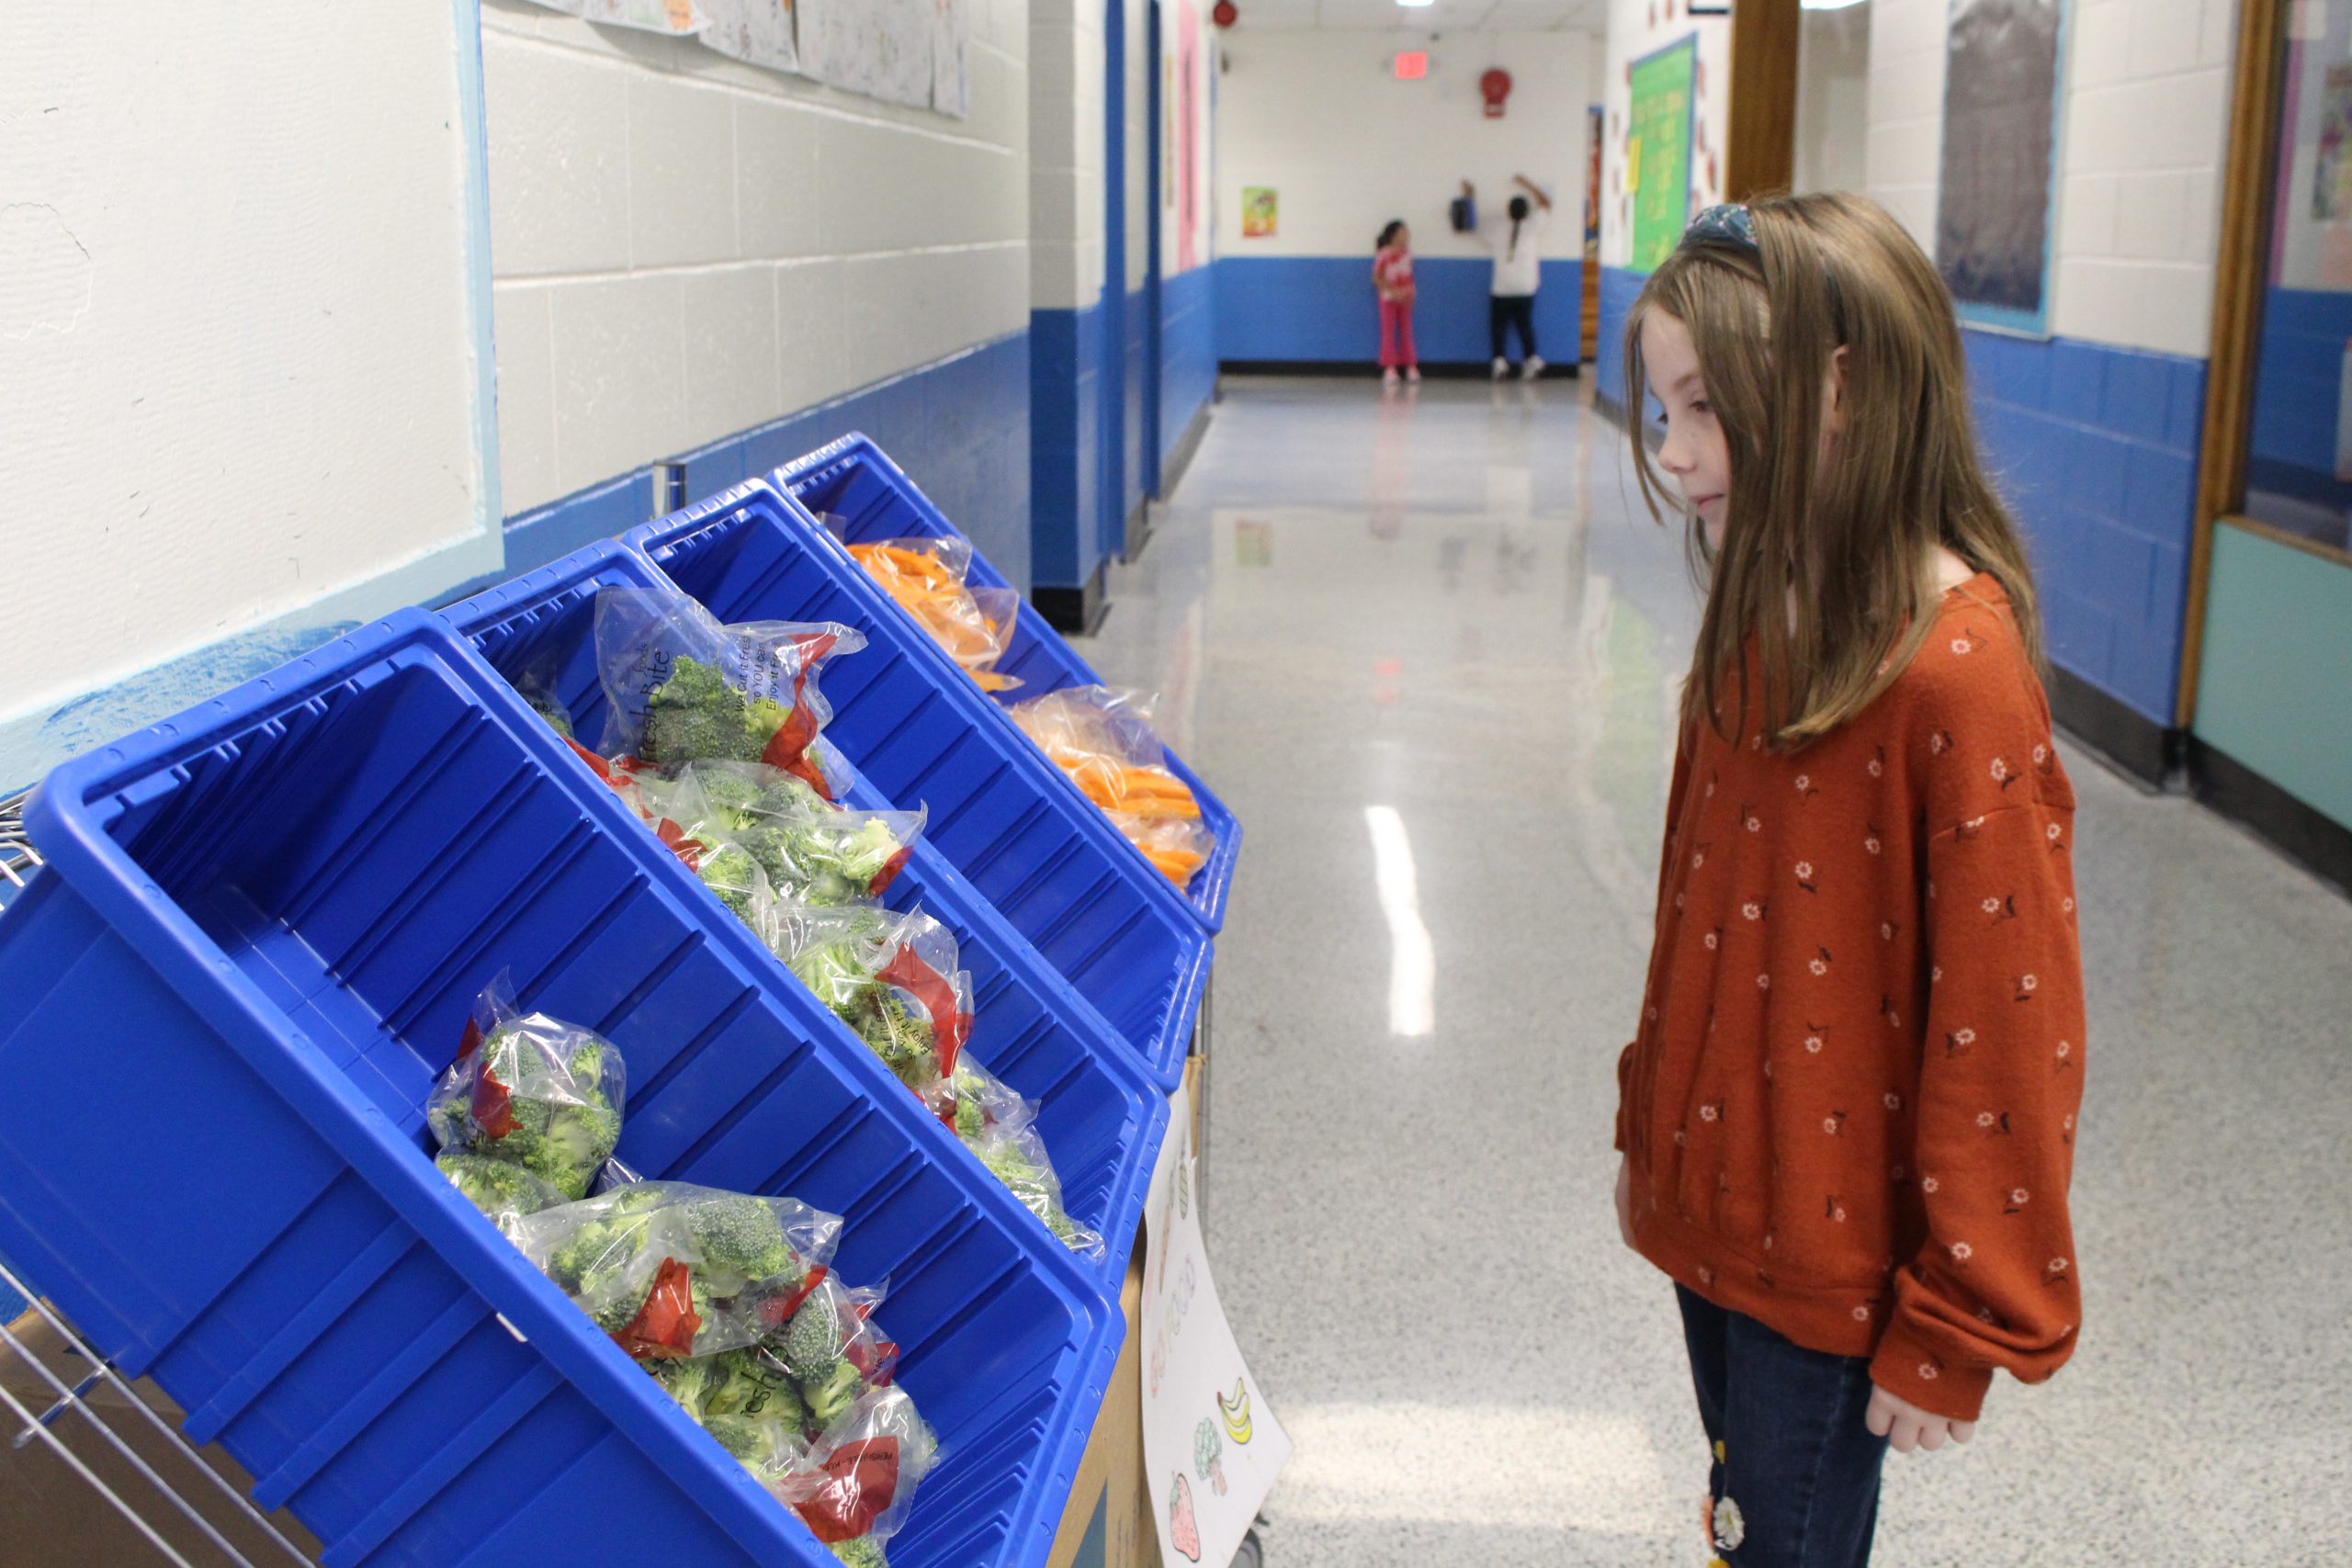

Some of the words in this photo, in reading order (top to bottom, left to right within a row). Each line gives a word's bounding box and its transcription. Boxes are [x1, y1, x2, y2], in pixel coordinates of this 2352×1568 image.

[640, 649, 670, 697] Bite
[740, 662, 749, 673] it
[752, 663, 765, 688] YOU
[771, 667, 779, 679] it
[736, 674, 748, 693] Cut
[735, 695, 745, 712] We
[753, 691, 762, 705] so
[766, 679, 780, 711] Enjoy
[901, 1021, 911, 1032] it
[910, 1029, 931, 1056] Enjoy
